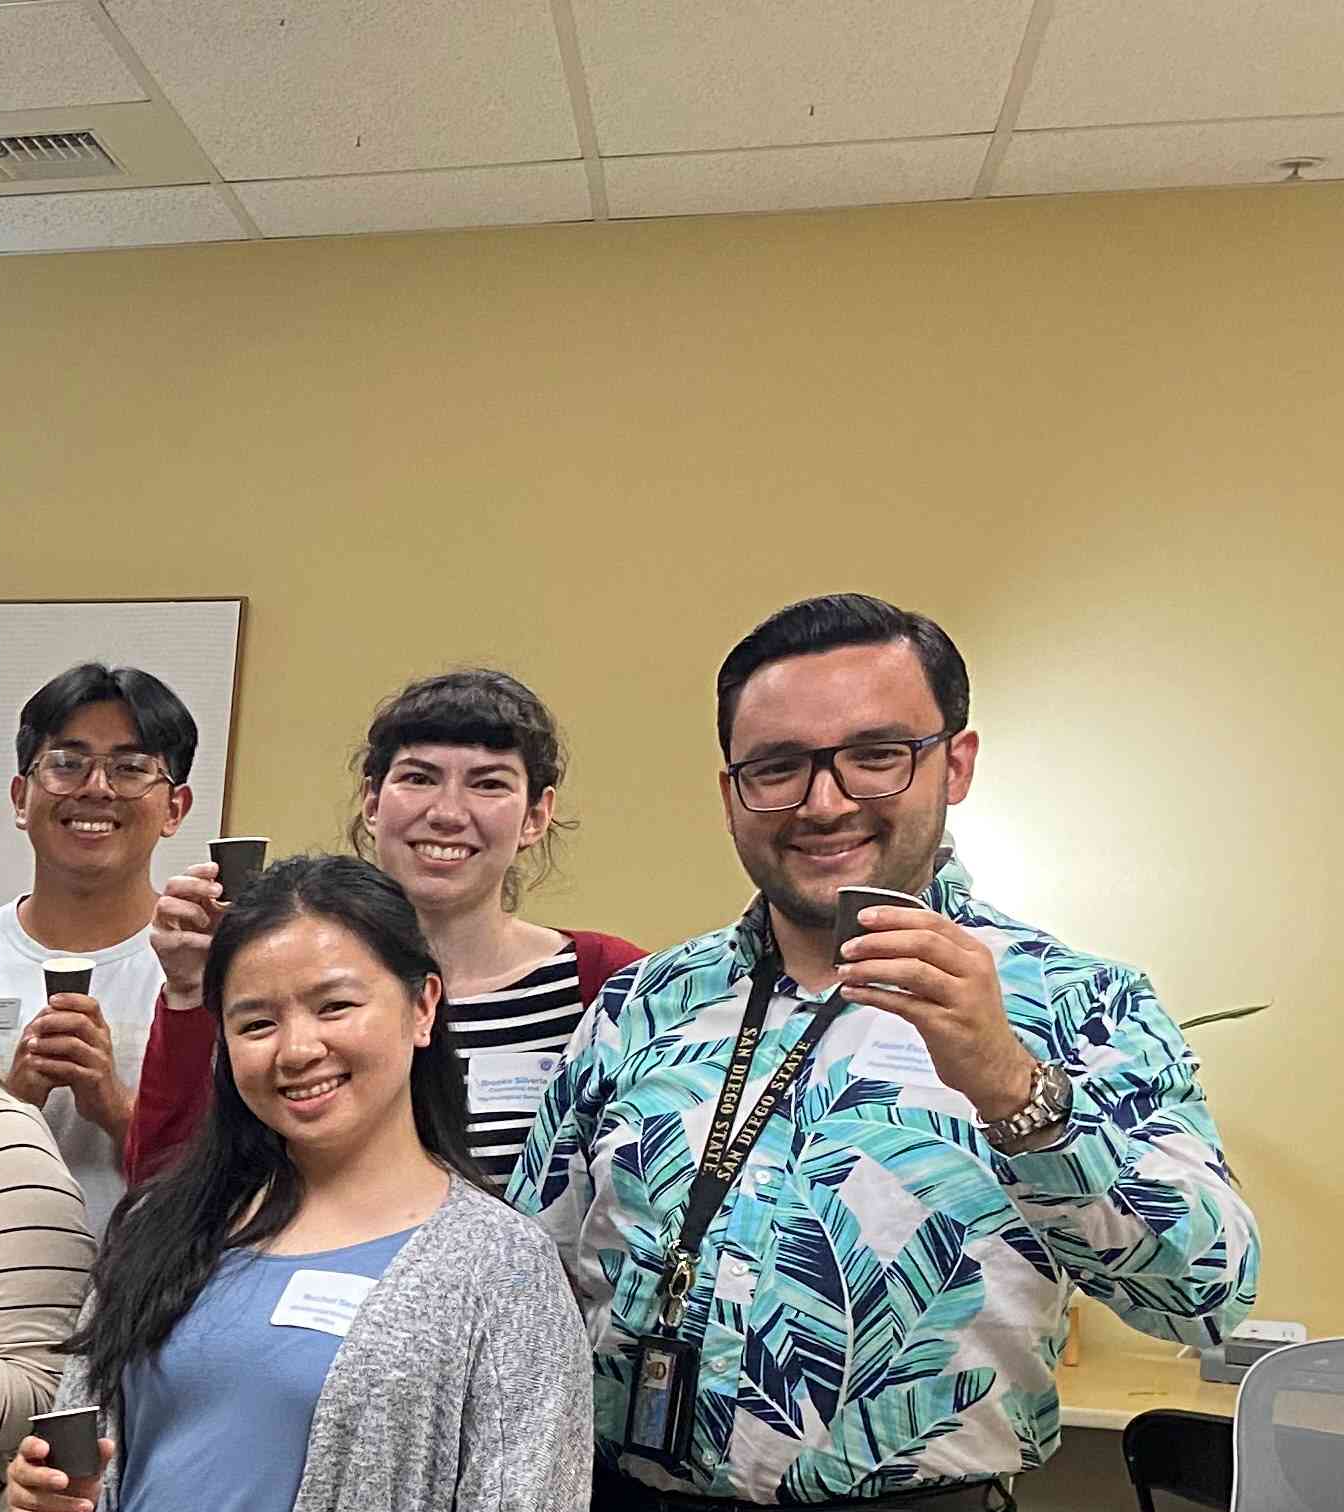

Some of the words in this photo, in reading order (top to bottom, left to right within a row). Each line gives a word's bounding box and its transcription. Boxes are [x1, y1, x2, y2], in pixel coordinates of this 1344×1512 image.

[737, 1027, 759, 1057] SAN
[716, 1150, 744, 1181] SAN
[739, 1094, 776, 1146] DIEGO
[772, 1040, 812, 1091] STATE
[720, 1064, 749, 1115] DIEGO
[702, 1121, 730, 1174] STATE
